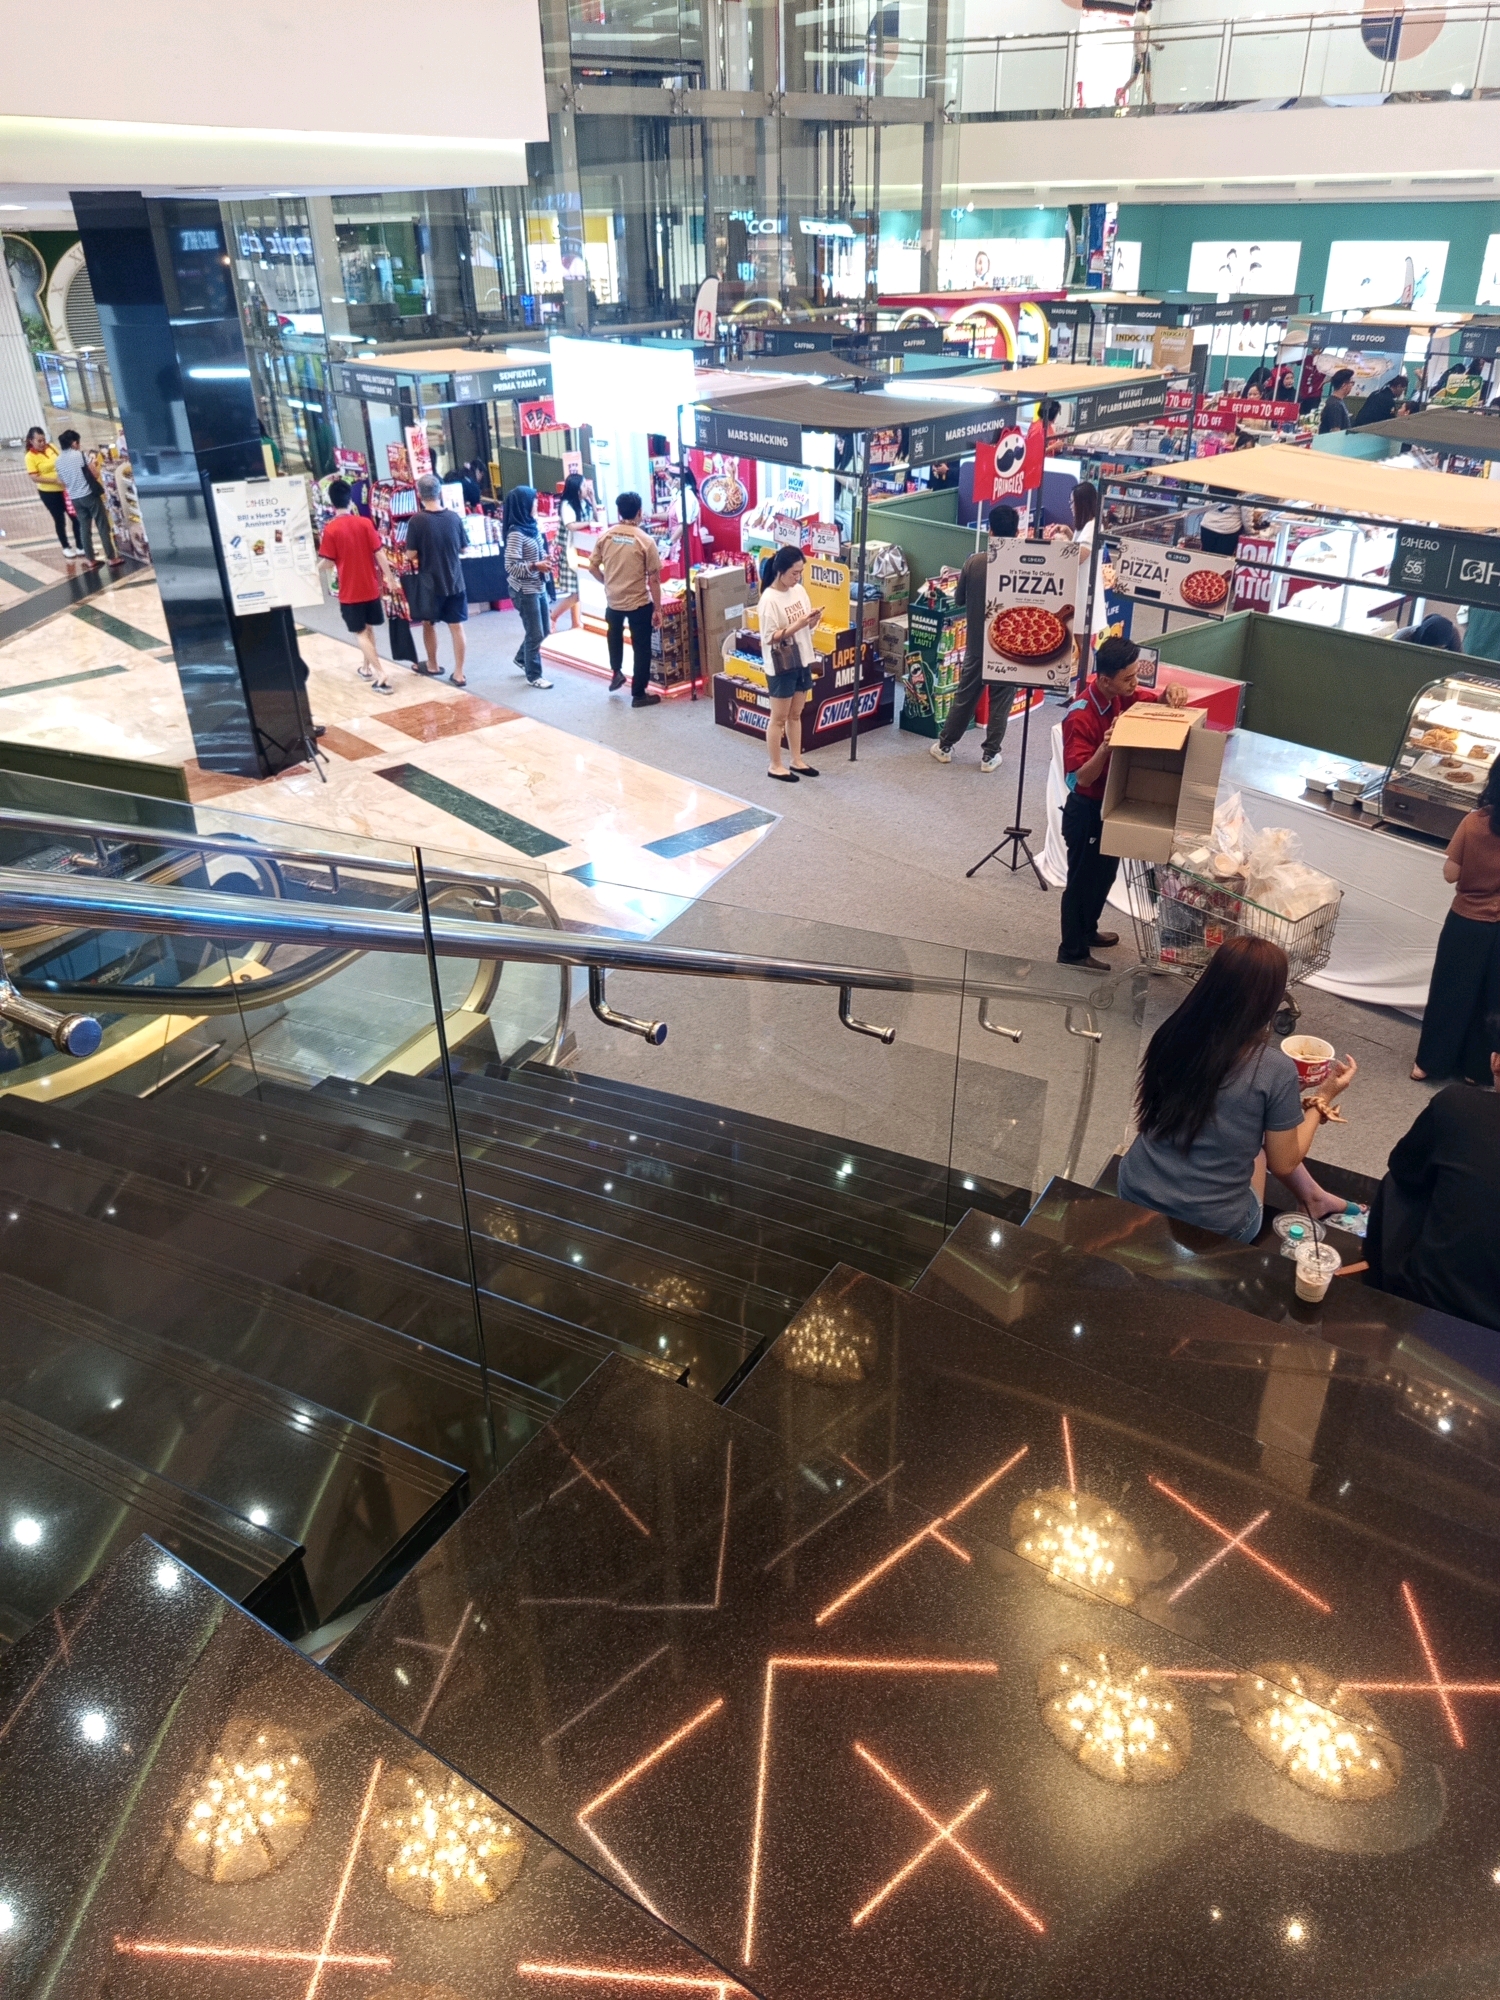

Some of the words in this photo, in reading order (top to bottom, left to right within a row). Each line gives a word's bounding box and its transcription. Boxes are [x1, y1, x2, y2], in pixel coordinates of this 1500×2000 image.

[903, 339, 926, 347] CAFFINO
[1351, 334, 1365, 342] KSG
[1366, 335, 1386, 343] FOOD
[794, 342, 815, 350] CAFFINO
[499, 368, 537, 381] SENFIENTA
[493, 382, 517, 393] PRIMA
[516, 379, 540, 389] TAMA
[539, 378, 547, 387] PT
[1119, 387, 1144, 400] MYFRUIT
[1107, 402, 1122, 413] LARIS
[1122, 399, 1142, 410] MANIS
[1142, 393, 1164, 407] UTAMA)
[1231, 403, 1242, 412] GET
[1243, 404, 1251, 412] UP
[1251, 405, 1259, 414] TO
[1273, 406, 1285, 416] OFF
[1210, 416, 1222, 426] OFF
[945, 429, 966, 442] MARS
[966, 418, 1005, 437] SNACKING
[727, 428, 749, 441] MARS
[749, 431, 788, 447] SNACKING
[788, 477, 804, 487] WOW
[992, 471, 1025, 501] PRINGLES
[783, 490, 805, 502] GORENG
[255, 512, 273, 520] Hero
[245, 519, 287, 528] Anniversary
[778, 527, 788, 537] 30
[817, 535, 827, 544] 25
[1120, 560, 1169, 583] PIZZA!
[999, 574, 1064, 596] PIZZA!
[1107, 605, 1120, 616] LIFE
[911, 614, 938, 626] RASAKAN
[911, 629, 936, 641] RUMPUT
[914, 637, 932, 648] LAUT!
[832, 644, 867, 670] LAPE?
[995, 666, 1006, 674] 44
[735, 687, 757, 704] LAPER?
